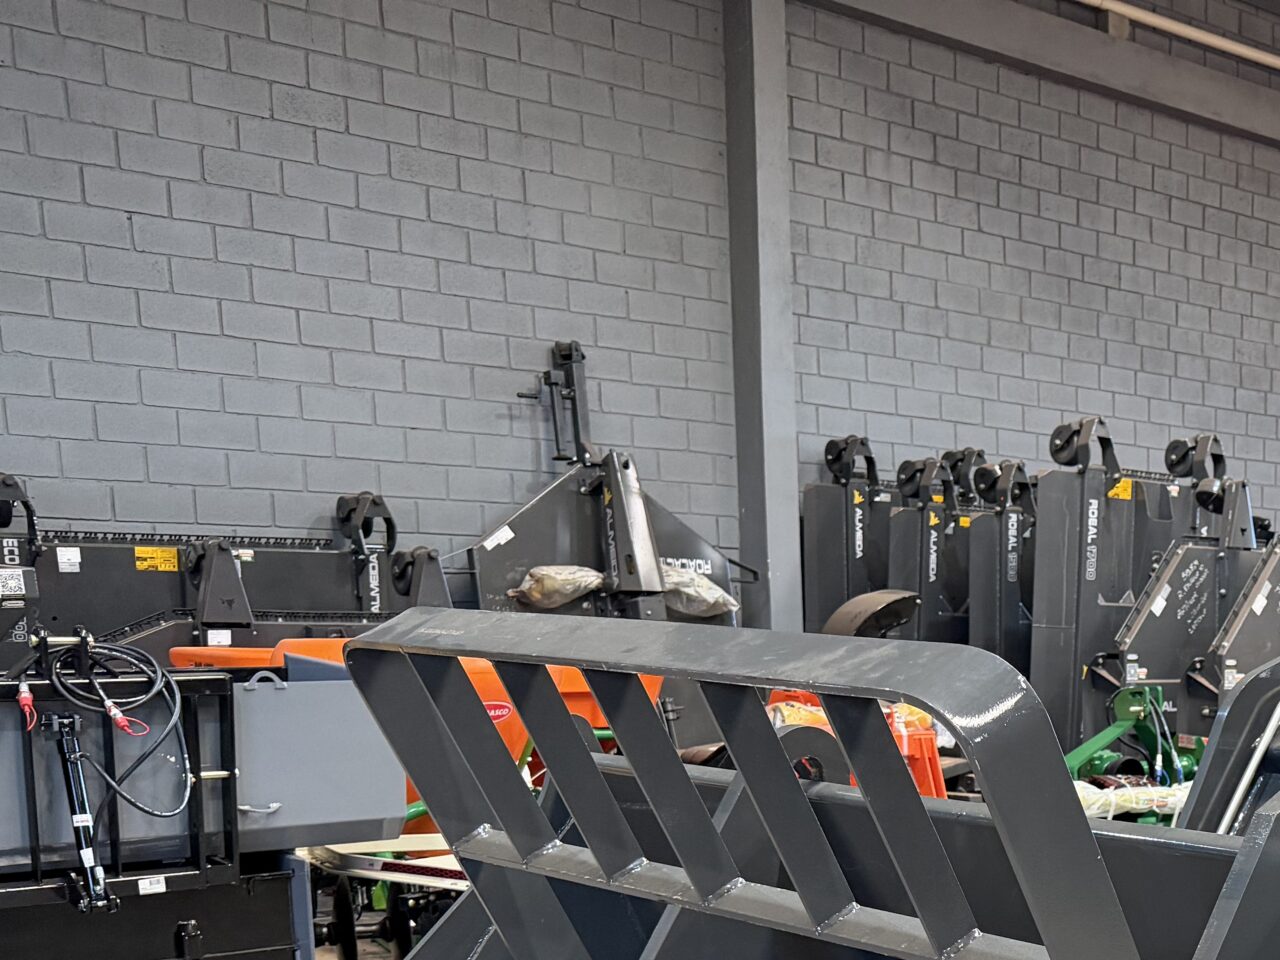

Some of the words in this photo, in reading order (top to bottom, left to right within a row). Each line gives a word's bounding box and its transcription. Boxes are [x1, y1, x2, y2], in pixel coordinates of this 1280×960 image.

[855, 507, 864, 559] ALMEIDA
[928, 529, 939, 583] ALMEIDA
[368, 553, 380, 613] ALMEIDA
